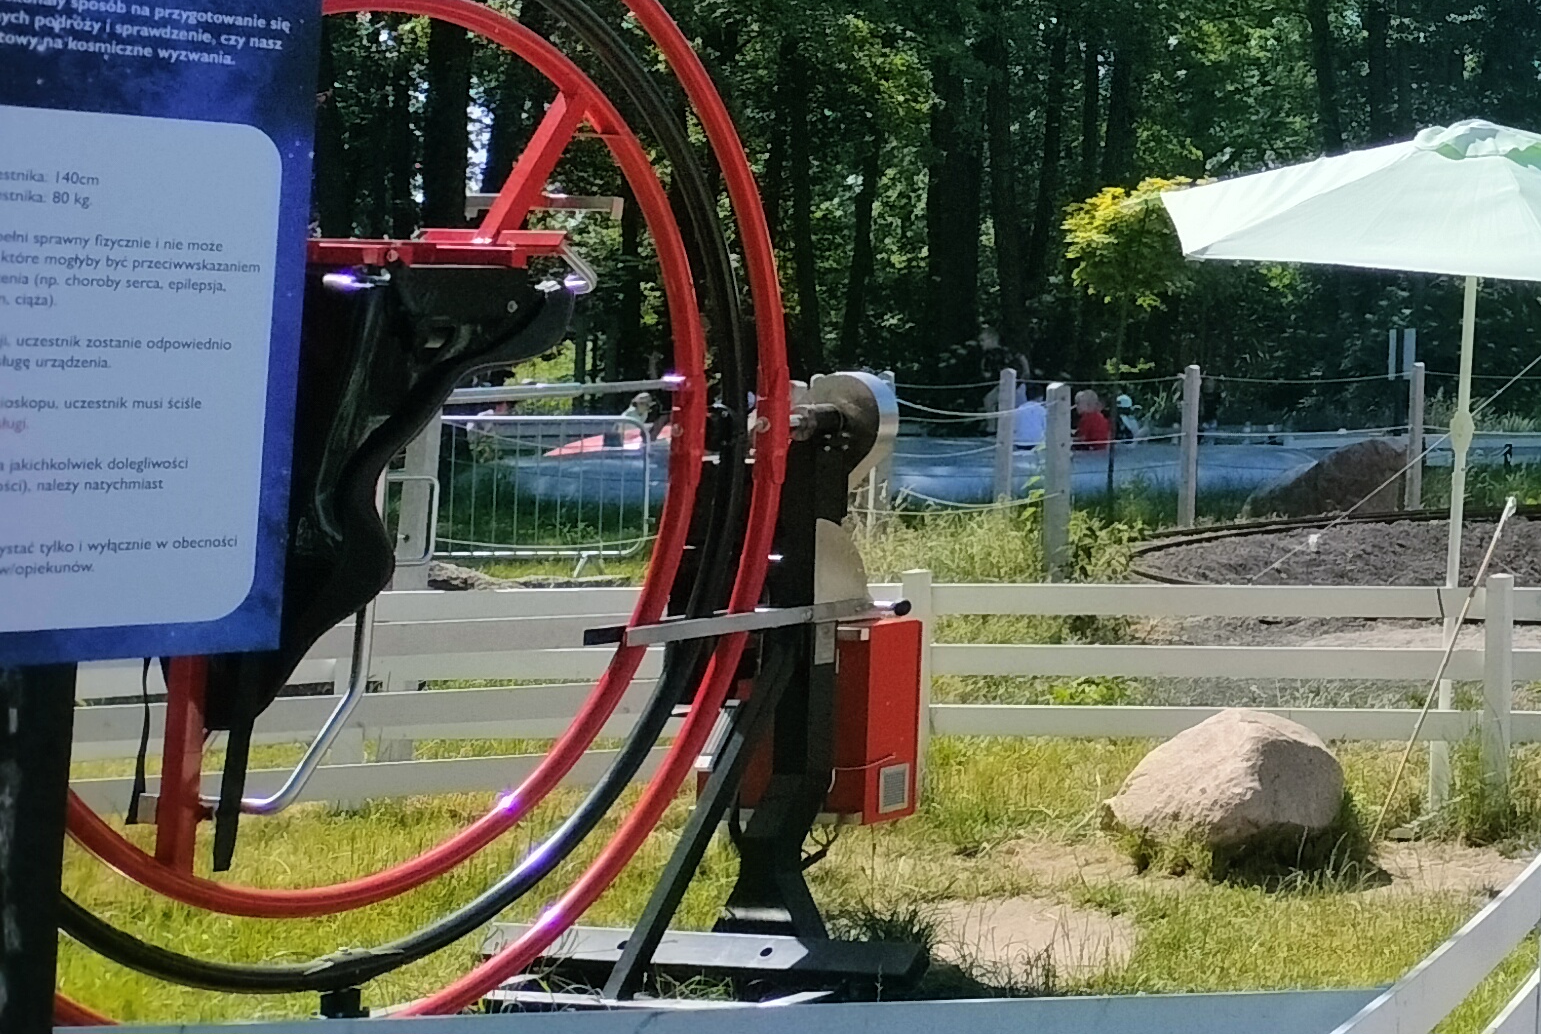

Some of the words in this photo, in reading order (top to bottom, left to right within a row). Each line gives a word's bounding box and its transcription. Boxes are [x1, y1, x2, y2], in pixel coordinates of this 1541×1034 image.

[131, 3, 150, 16] na
[155, 7, 266, 29] przygotowanie
[270, 17, 291, 34] się
[35, 13, 101, 34] podróży
[105, 19, 110, 33] i
[115, 23, 217, 46] sprawdzenie,
[220, 35, 245, 49] czy
[250, 37, 283, 50] nasz
[43, 36, 63, 50] na
[68, 37, 153, 58] kosmiczne
[158, 46, 235, 65] wyzwania.
[55, 170, 100, 186] 140cm
[52, 191, 70, 204] 80
[33, 233, 90, 250] sprawny
[95, 233, 151, 251] fizycznie
[155, 237, 160, 249] i
[163, 238, 184, 251] nie
[187, 240, 223, 253] może
[1, 250, 39, 265] które
[44, 253, 101, 270] mogłyby
[106, 254, 128, 271] być
[132, 258, 260, 273] przeciwwskazaniem
[34, 273, 59, 289] (np.
[65, 274, 121, 292] choroby
[125, 278, 163, 290] serca,
[168, 278, 226, 295] epilepsja,
[15, 293, 57, 308] ciąża).
[16, 335, 81, 347] uczestnik
[86, 336, 142, 350] zostanie
[146, 337, 232, 354] odpowiednio
[36, 355, 111, 371] urządzenia.
[64, 396, 128, 409] uczestnik
[132, 397, 163, 409] musi
[167, 396, 202, 410] ściśle
[9, 457, 103, 474] jakichkolwiek
[107, 457, 188, 473] dolegliwości
[37, 478, 79, 495] należy
[85, 477, 163, 494] natychmiast
[40, 540, 74, 557] tylko
[88, 538, 151, 556] wyłącznie
[156, 539, 169, 549] w
[172, 534, 238, 550] obecności
